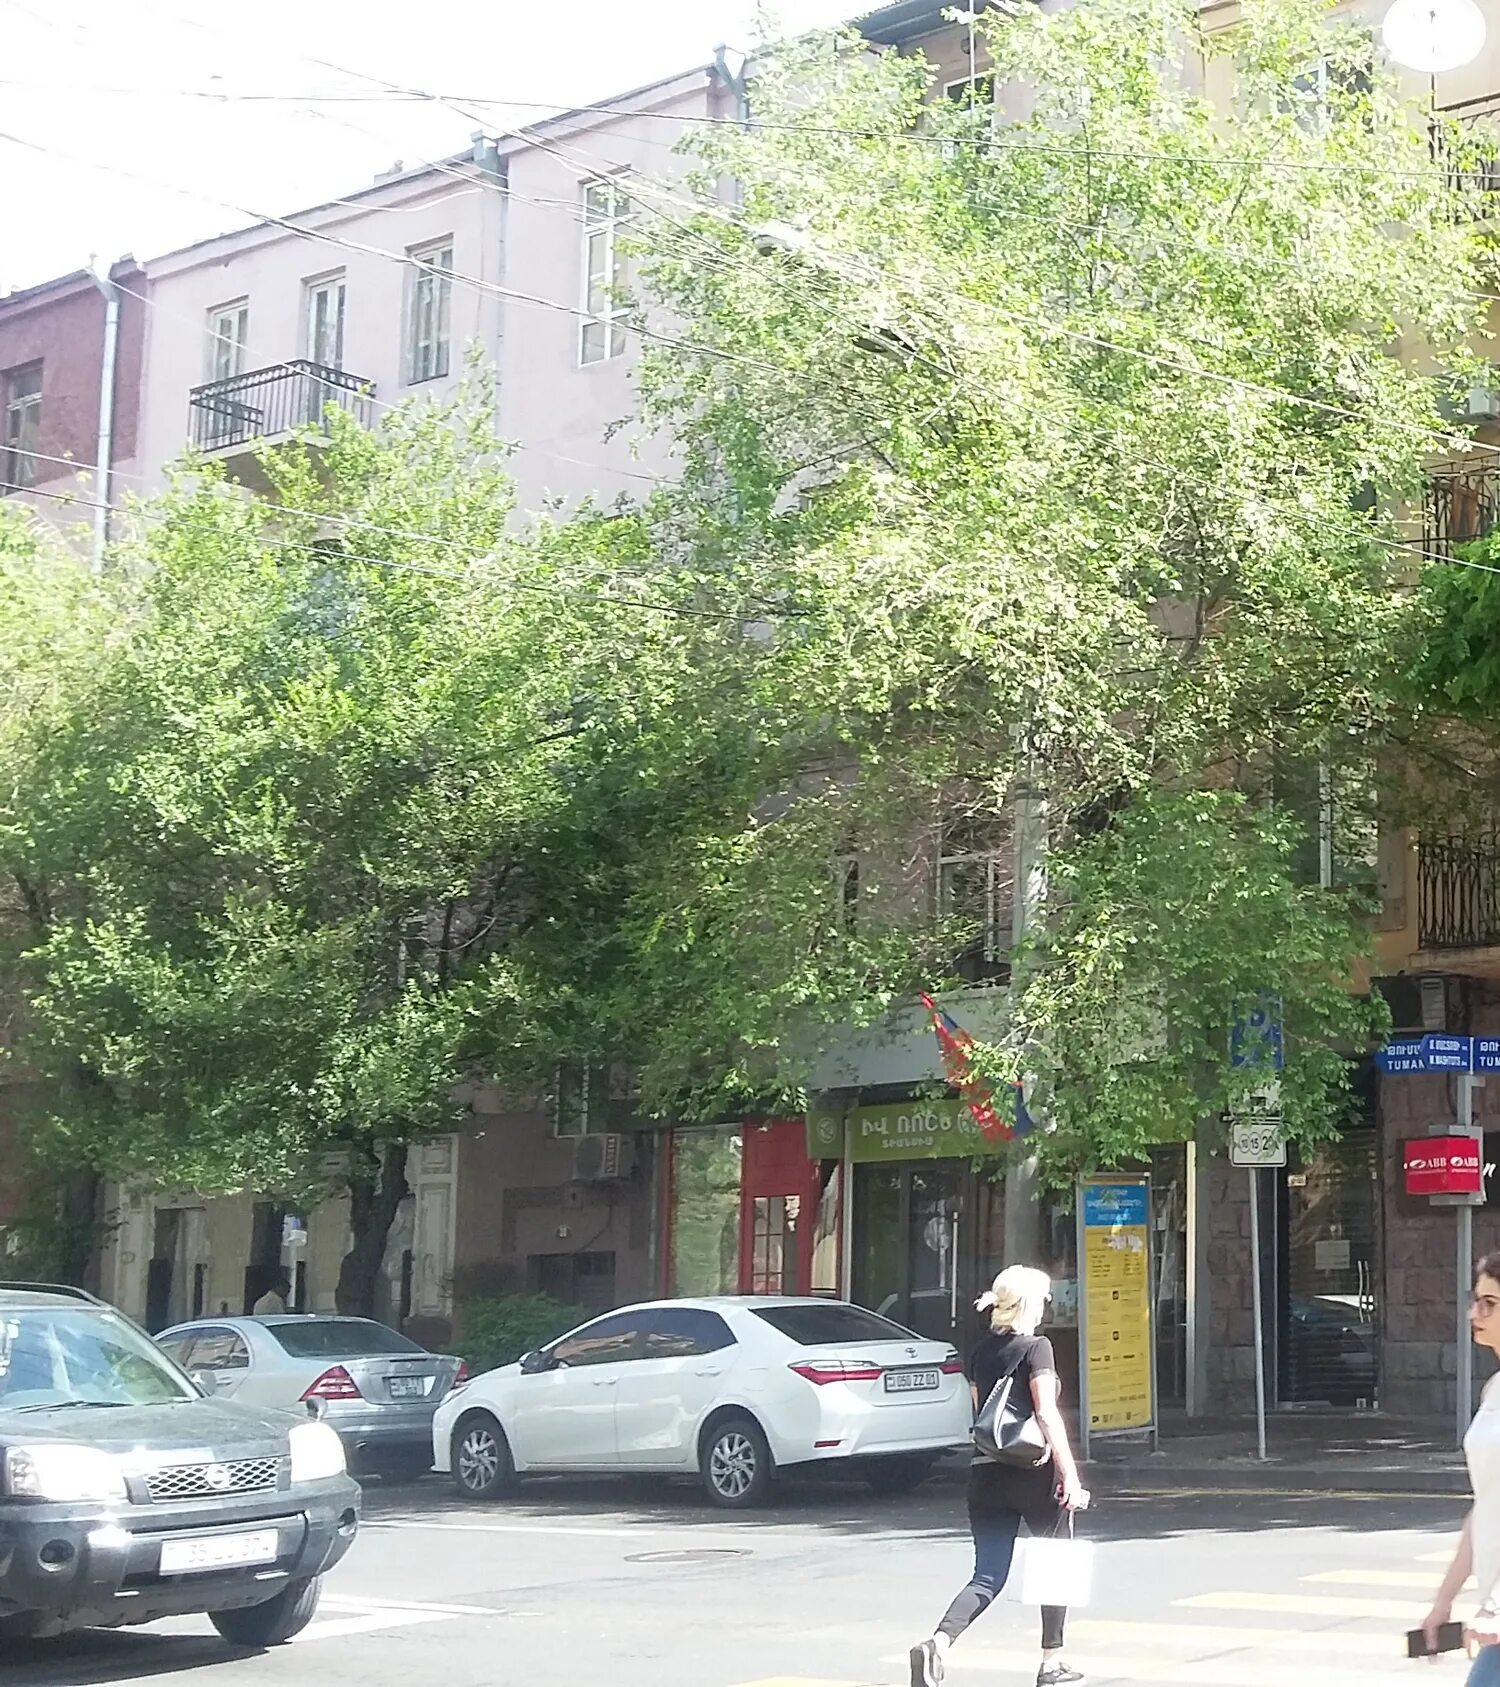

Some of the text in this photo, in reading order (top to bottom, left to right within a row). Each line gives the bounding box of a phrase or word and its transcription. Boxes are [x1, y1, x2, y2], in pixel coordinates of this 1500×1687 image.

[1251, 1137, 1259, 1150] 15
[1426, 1157, 1447, 1168] ABB
[913, 1374, 924, 1386] ZZ
